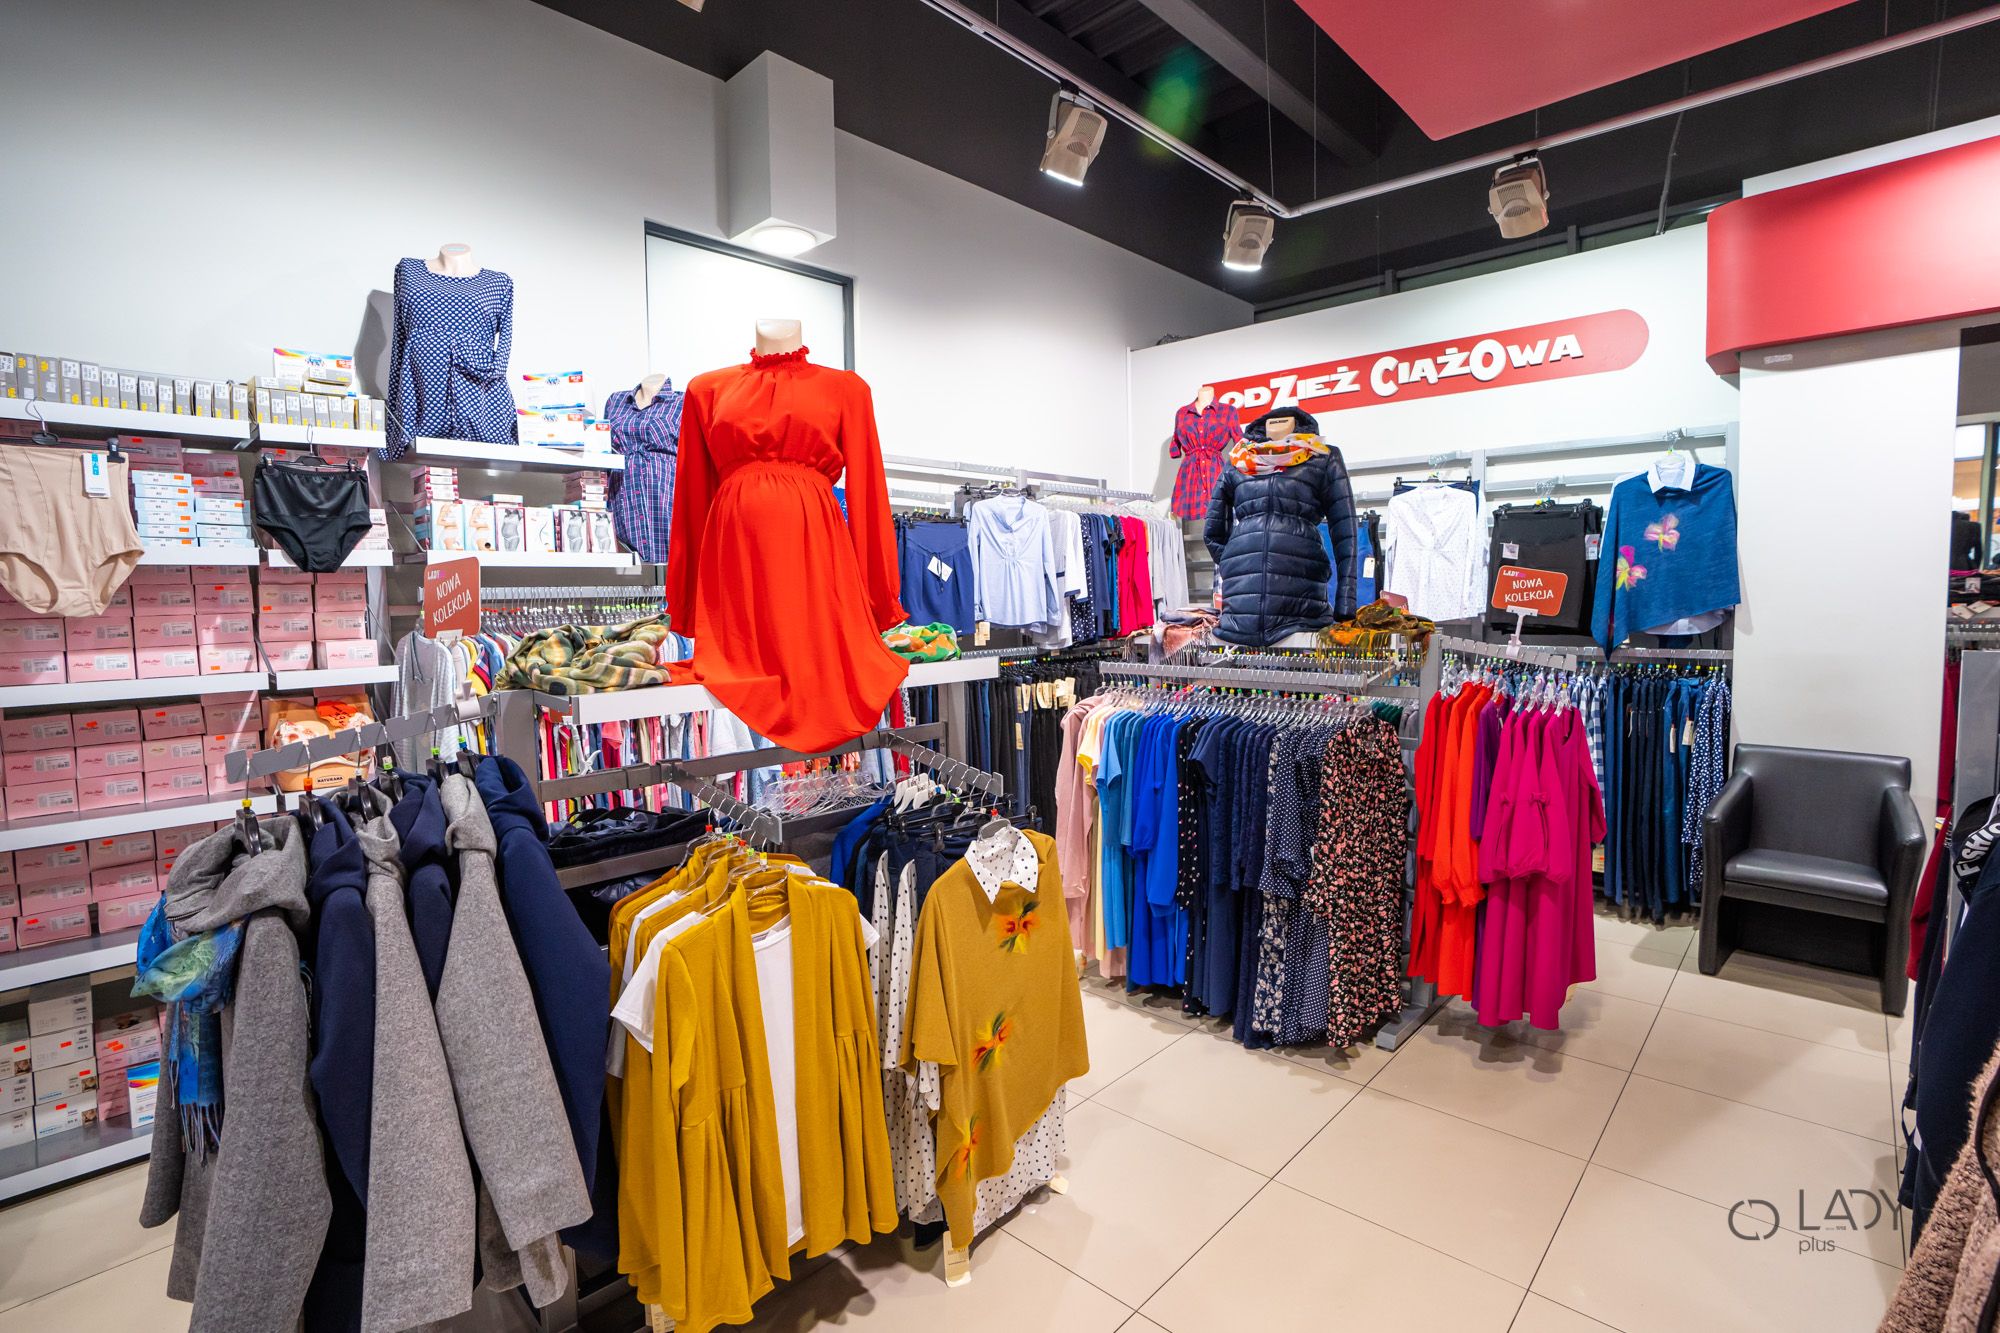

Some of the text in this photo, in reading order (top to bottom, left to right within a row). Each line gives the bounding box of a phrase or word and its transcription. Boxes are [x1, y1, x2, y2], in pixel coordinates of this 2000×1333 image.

[1219, 333, 1584, 410] ODZIEŻ CIĄŻOWA
[436, 572, 462, 601] NOWA
[1504, 589, 1554, 603] KOLEKCJA
[1512, 577, 1543, 590] NOWA
[432, 588, 473, 627] KOLEKCJA
